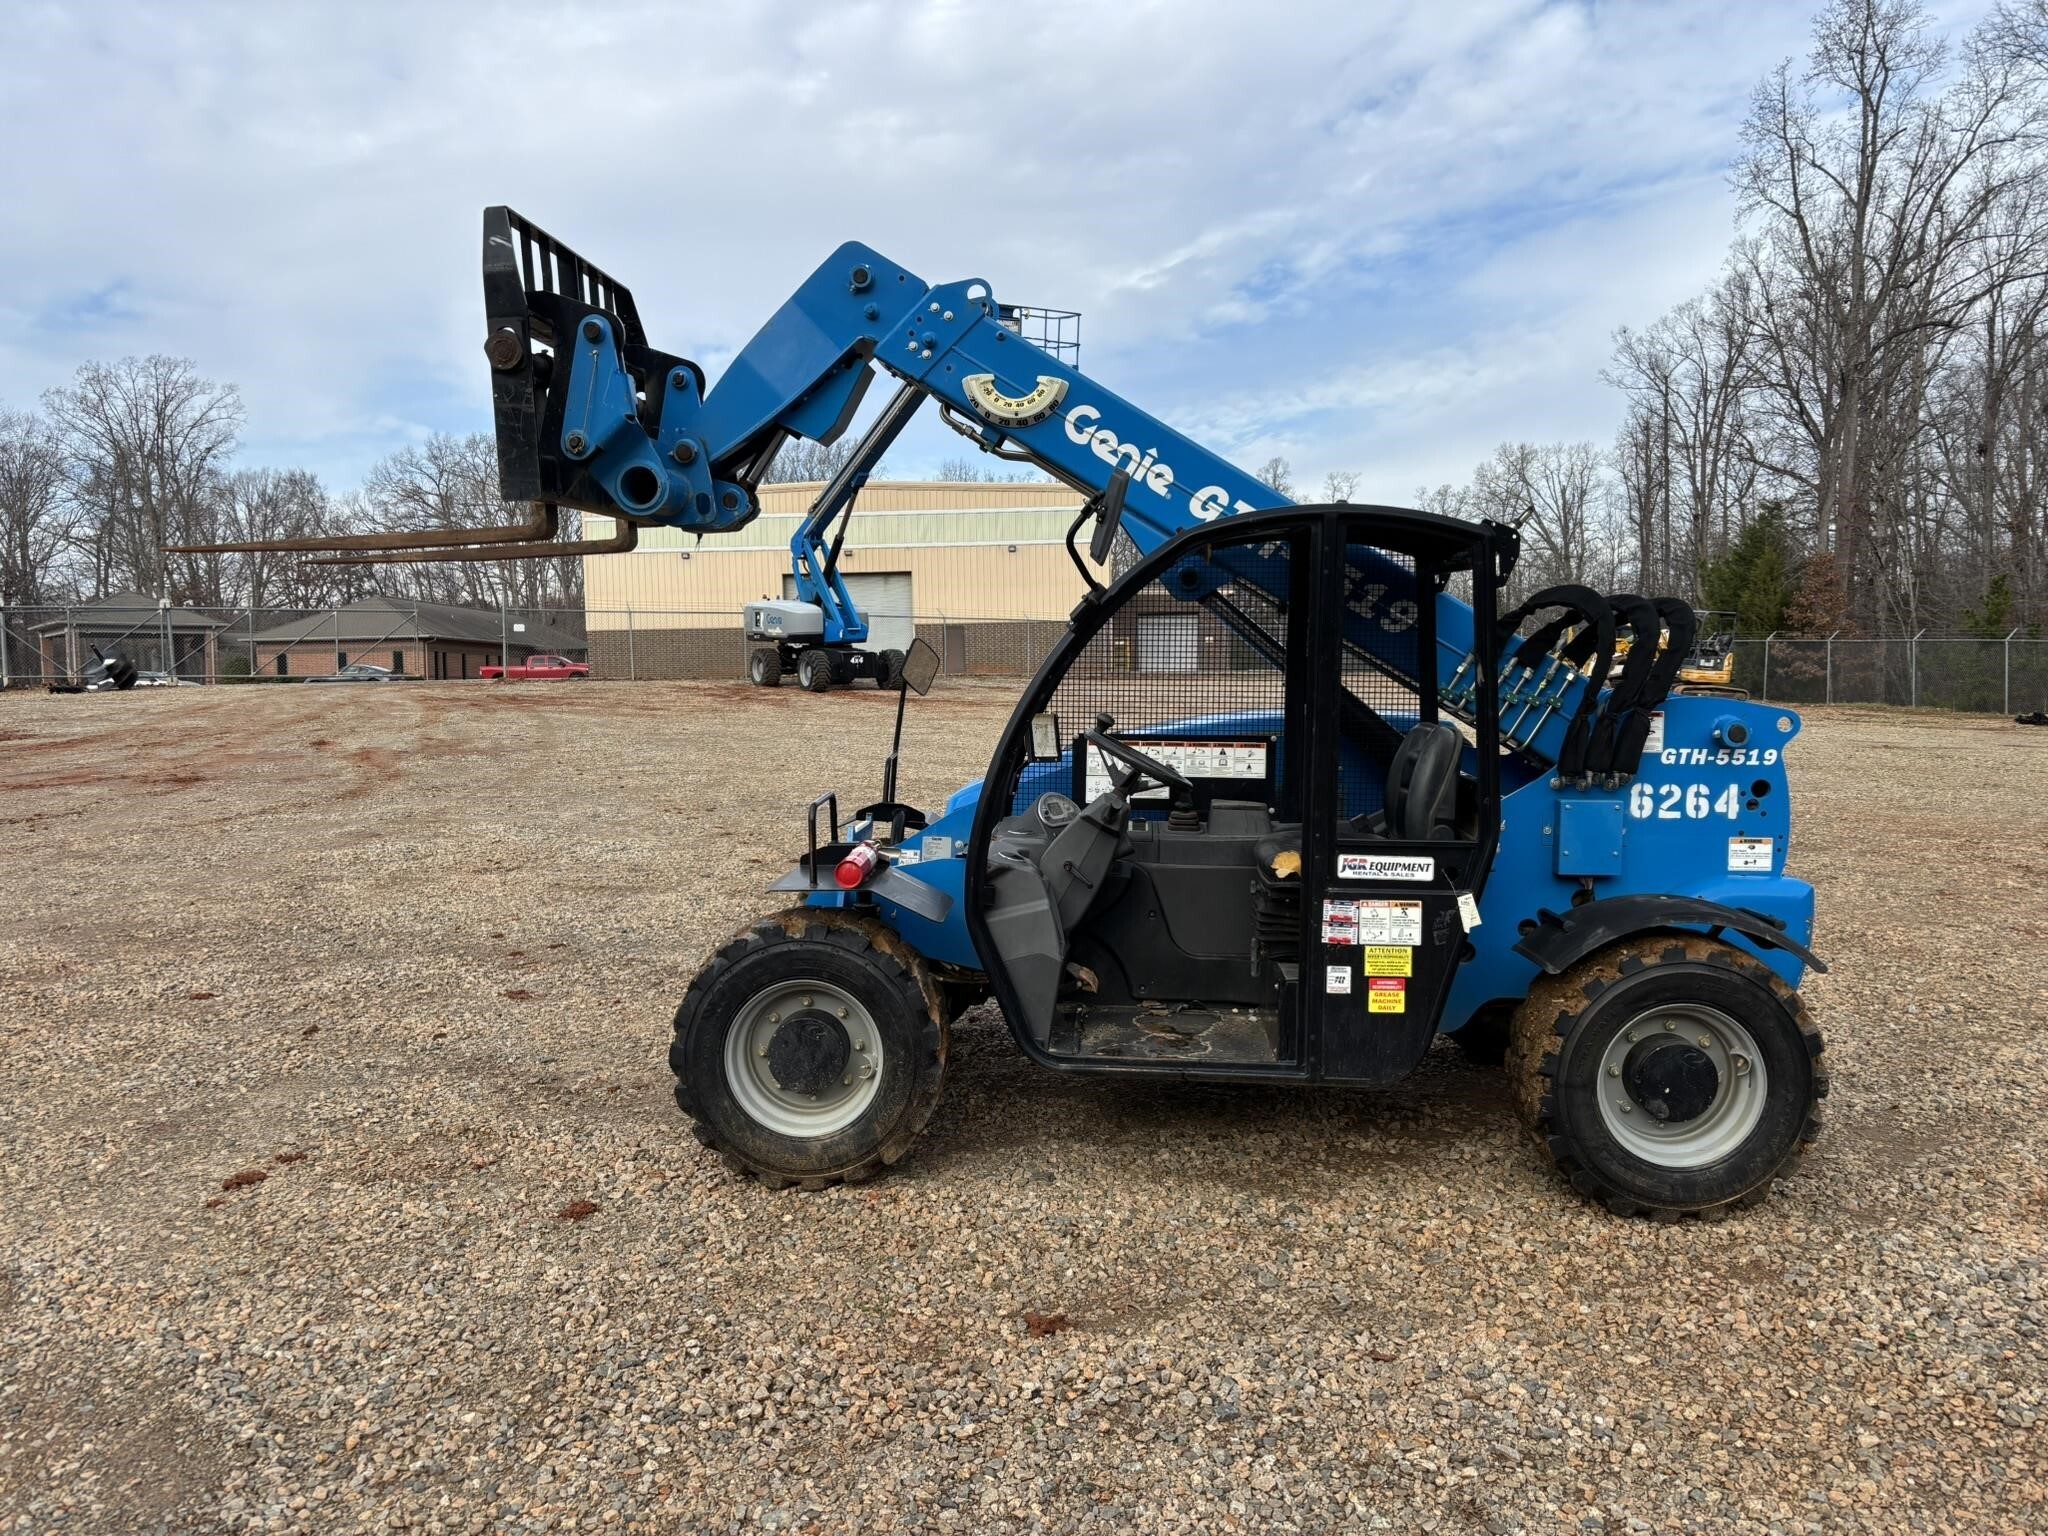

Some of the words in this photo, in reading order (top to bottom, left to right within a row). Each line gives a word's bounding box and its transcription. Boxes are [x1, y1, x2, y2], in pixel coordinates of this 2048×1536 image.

[984, 411, 991, 419] 0
[1016, 418, 1029, 426] 40
[1064, 404, 1175, 498] Genie
[1660, 748, 1778, 766] GTH-5519
[1629, 782, 1740, 820] 6264
[1340, 857, 1368, 873] JGR
[1368, 861, 1432, 873] EQUIPMENT
